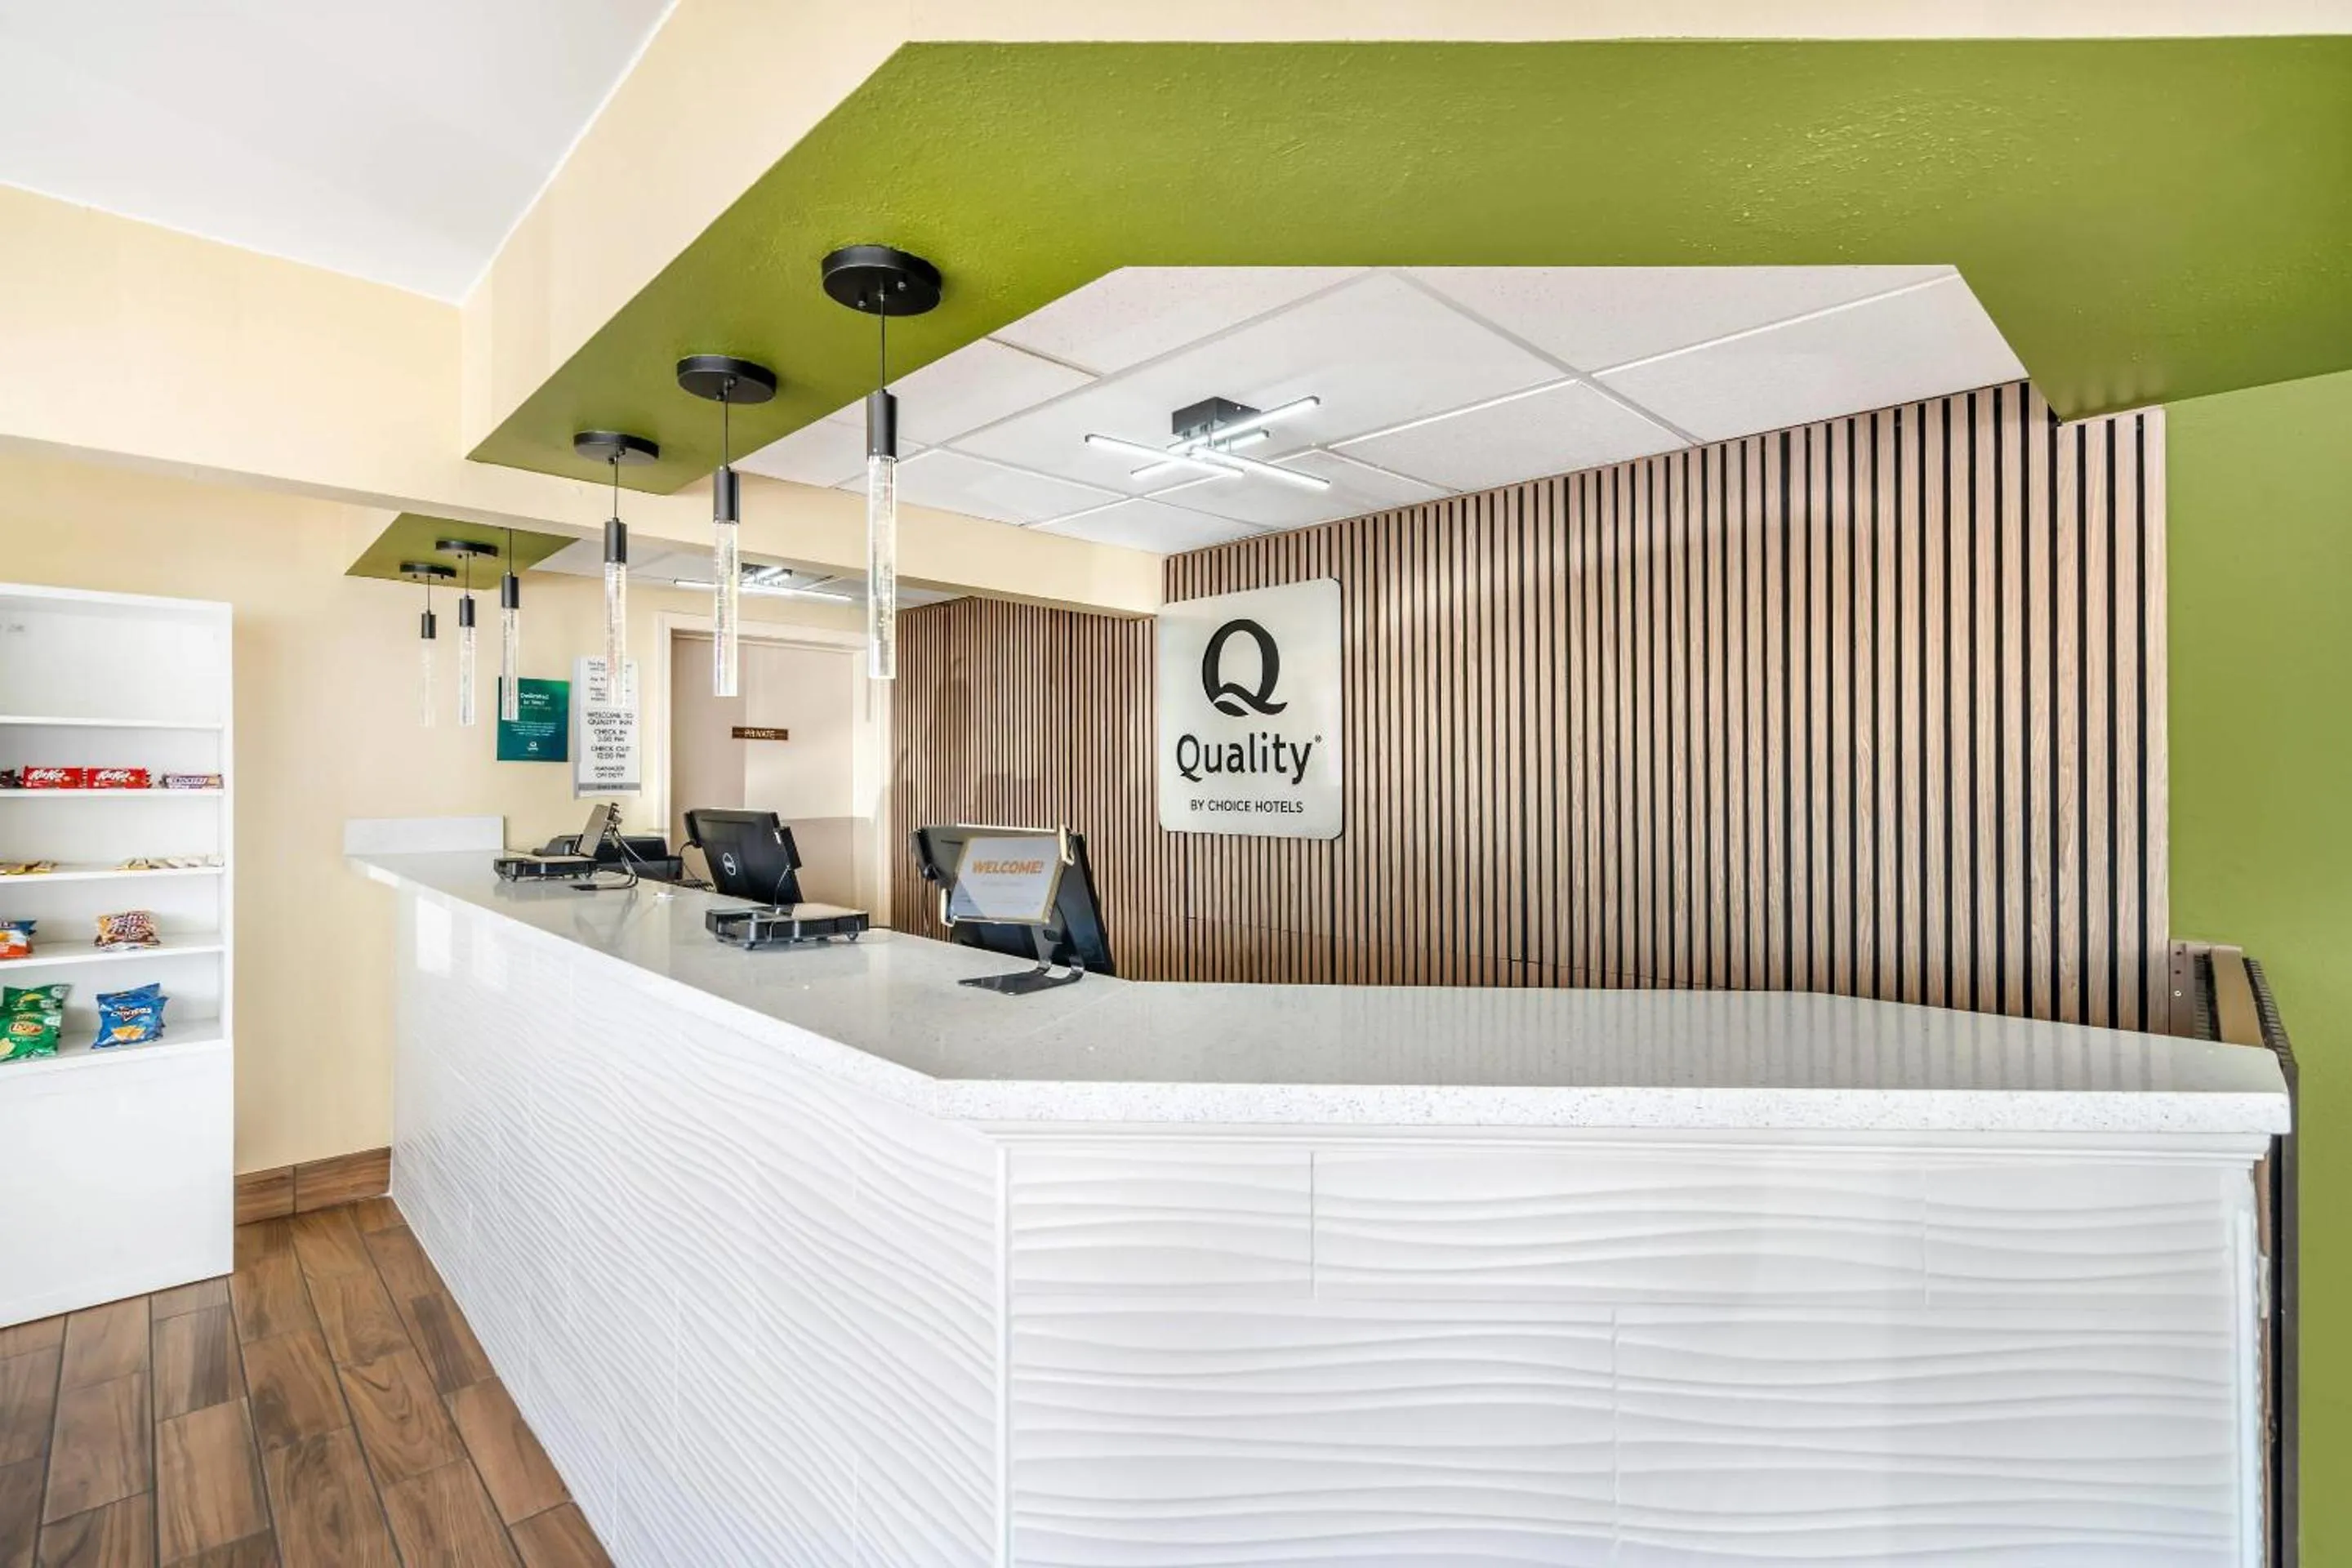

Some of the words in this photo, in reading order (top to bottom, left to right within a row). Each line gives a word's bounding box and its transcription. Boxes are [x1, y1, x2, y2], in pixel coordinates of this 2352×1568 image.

[1202, 618, 1288, 717] Q
[744, 728, 775, 739] PRIVATE
[1176, 731, 1312, 785] Quality
[1191, 800, 1205, 811] BY
[1208, 800, 1252, 812] CHOICE
[1255, 800, 1303, 813] HOTELS
[972, 860, 1045, 875] WELCOME!
